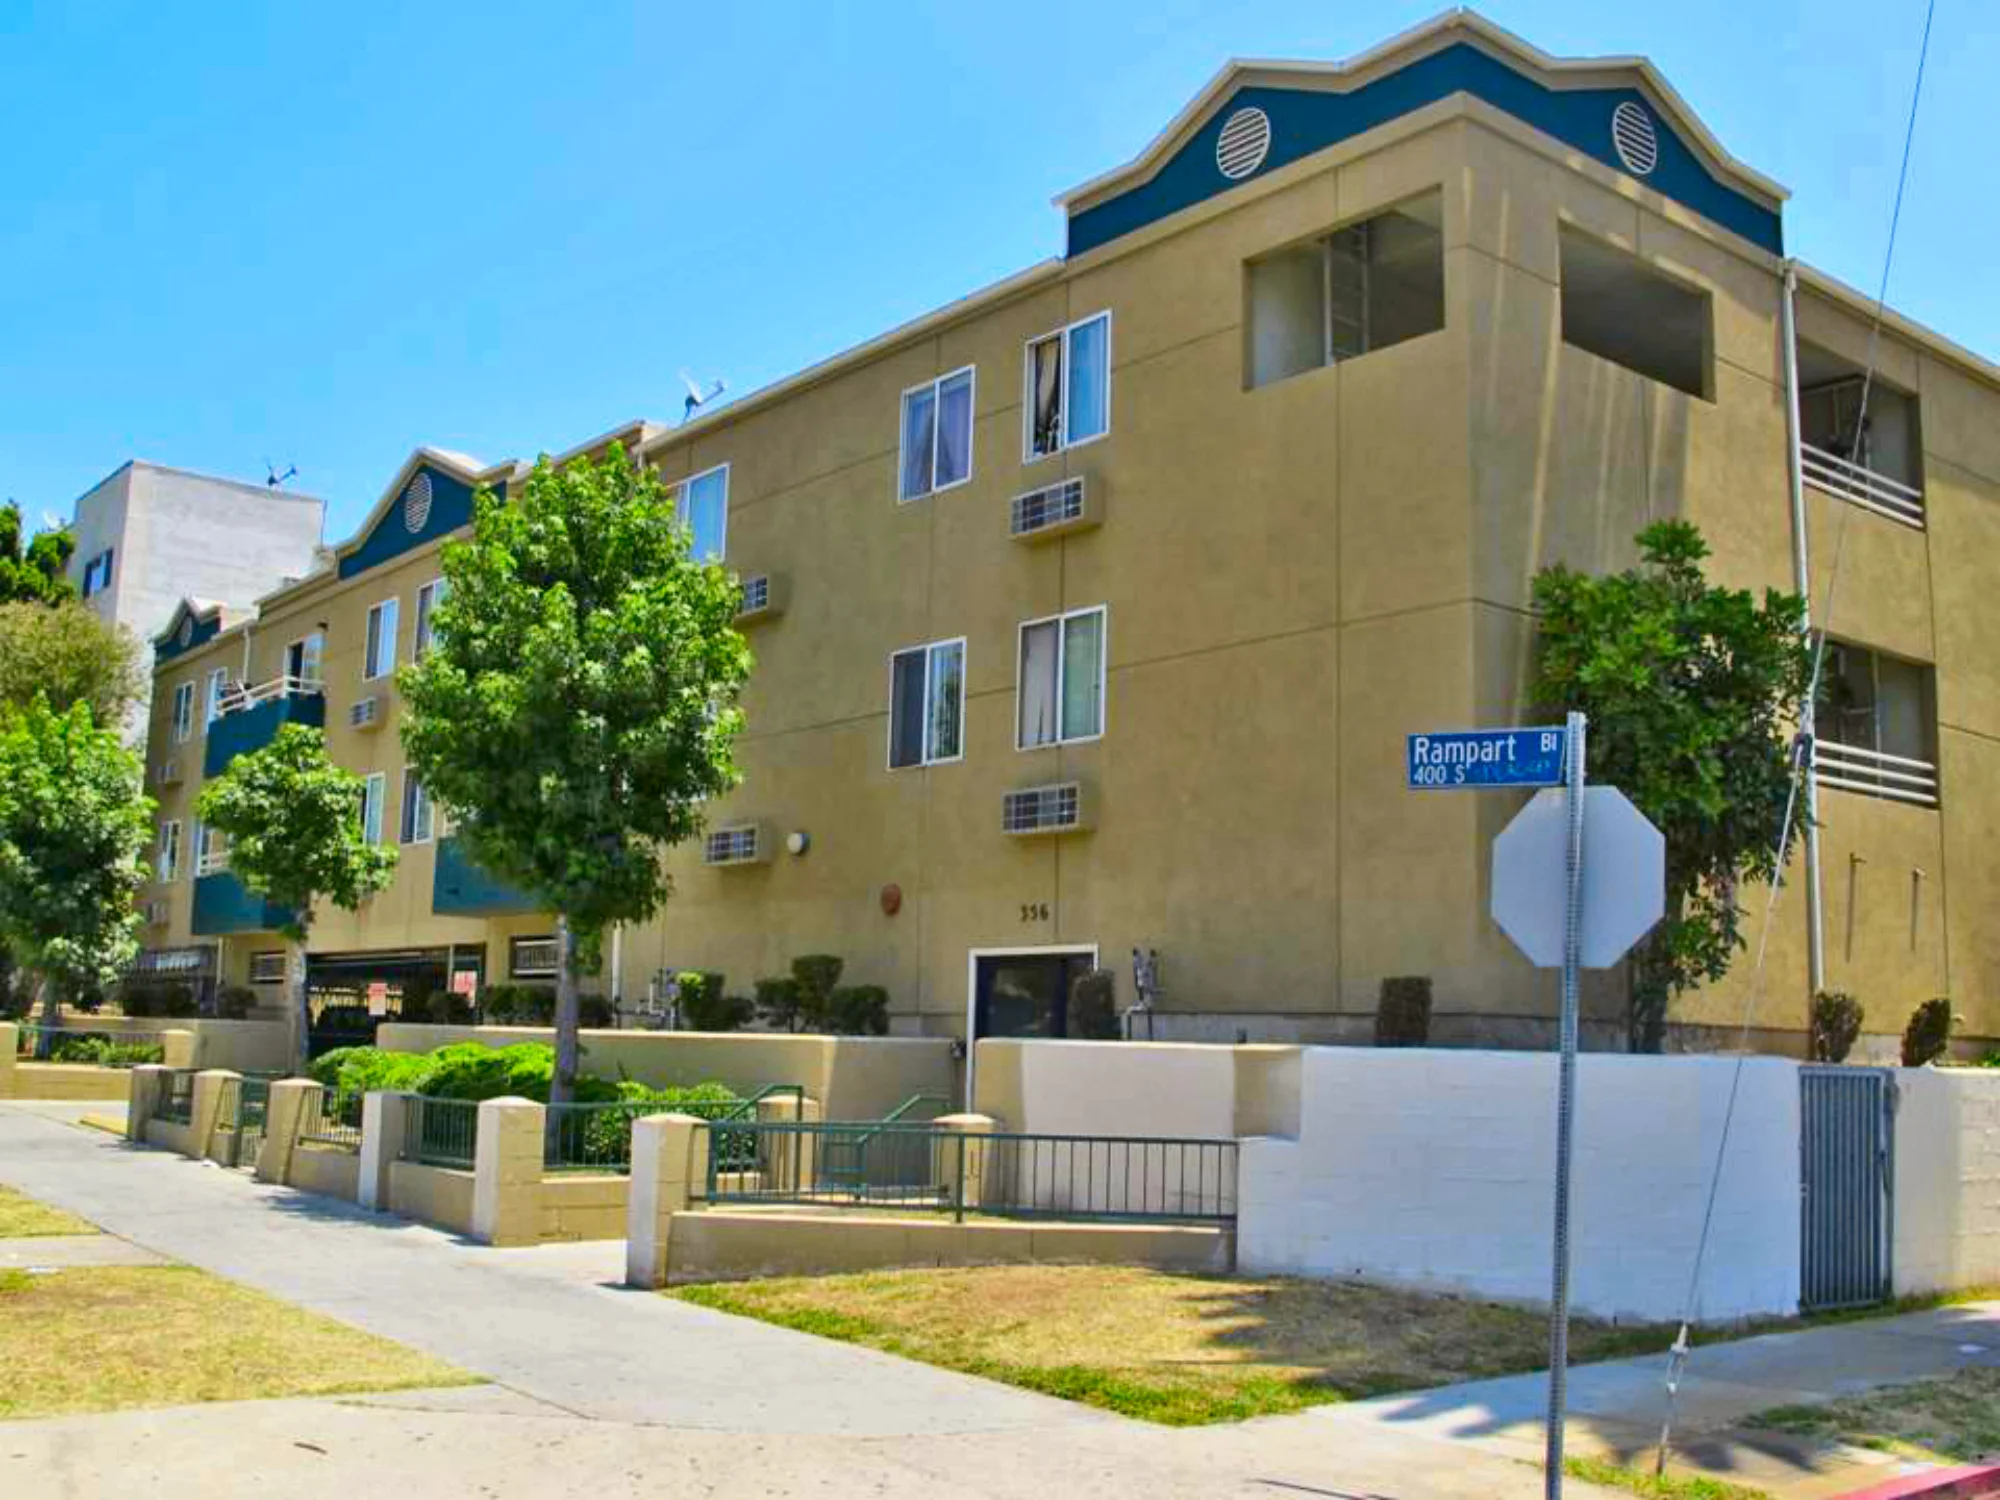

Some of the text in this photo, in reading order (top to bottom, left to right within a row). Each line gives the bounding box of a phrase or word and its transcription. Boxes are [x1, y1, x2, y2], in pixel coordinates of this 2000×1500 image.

[1414, 735, 1516, 769] Rampart
[1413, 765, 1446, 784] 400
[1454, 764, 1466, 784] S
